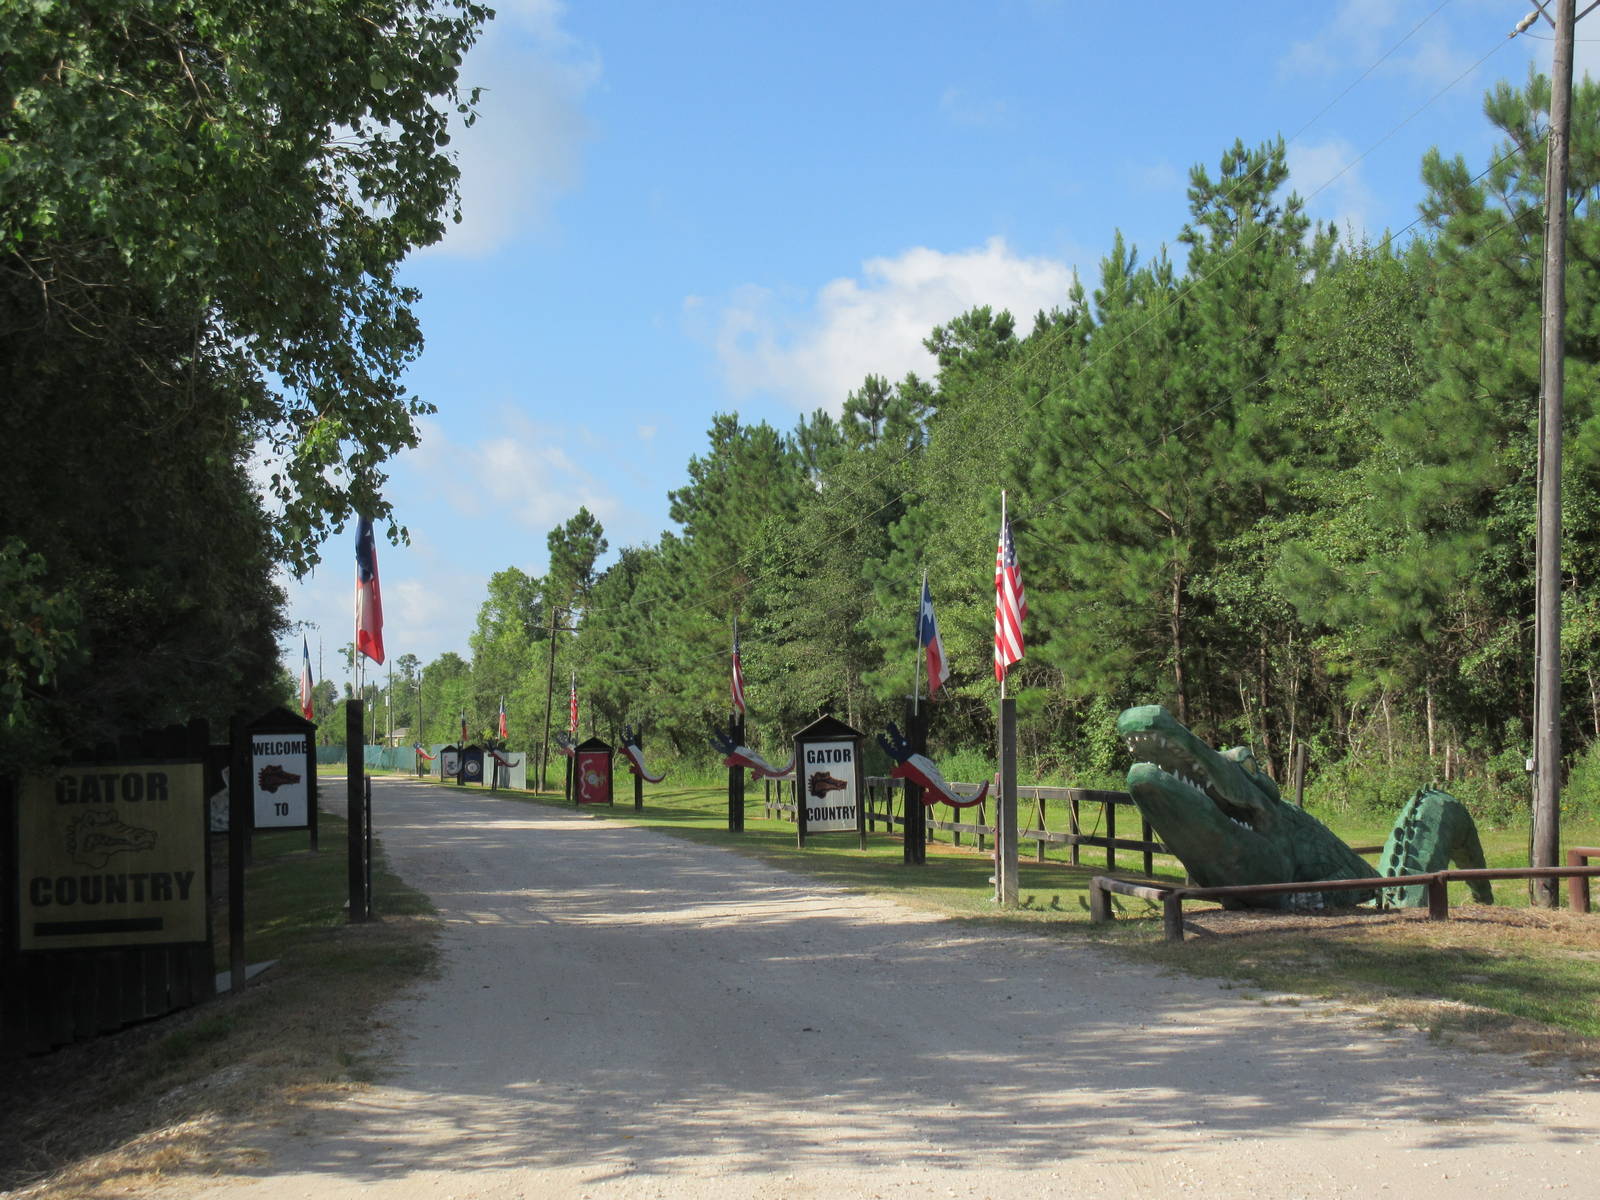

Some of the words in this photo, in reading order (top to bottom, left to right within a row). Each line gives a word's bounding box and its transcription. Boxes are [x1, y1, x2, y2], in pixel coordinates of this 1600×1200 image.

[253, 741, 308, 756] WELCOME
[807, 749, 851, 764] GATOR
[56, 772, 168, 805] GATOR
[274, 802, 289, 817] TO
[807, 806, 856, 821] COUNTRY
[30, 871, 194, 907] COUNTRY
